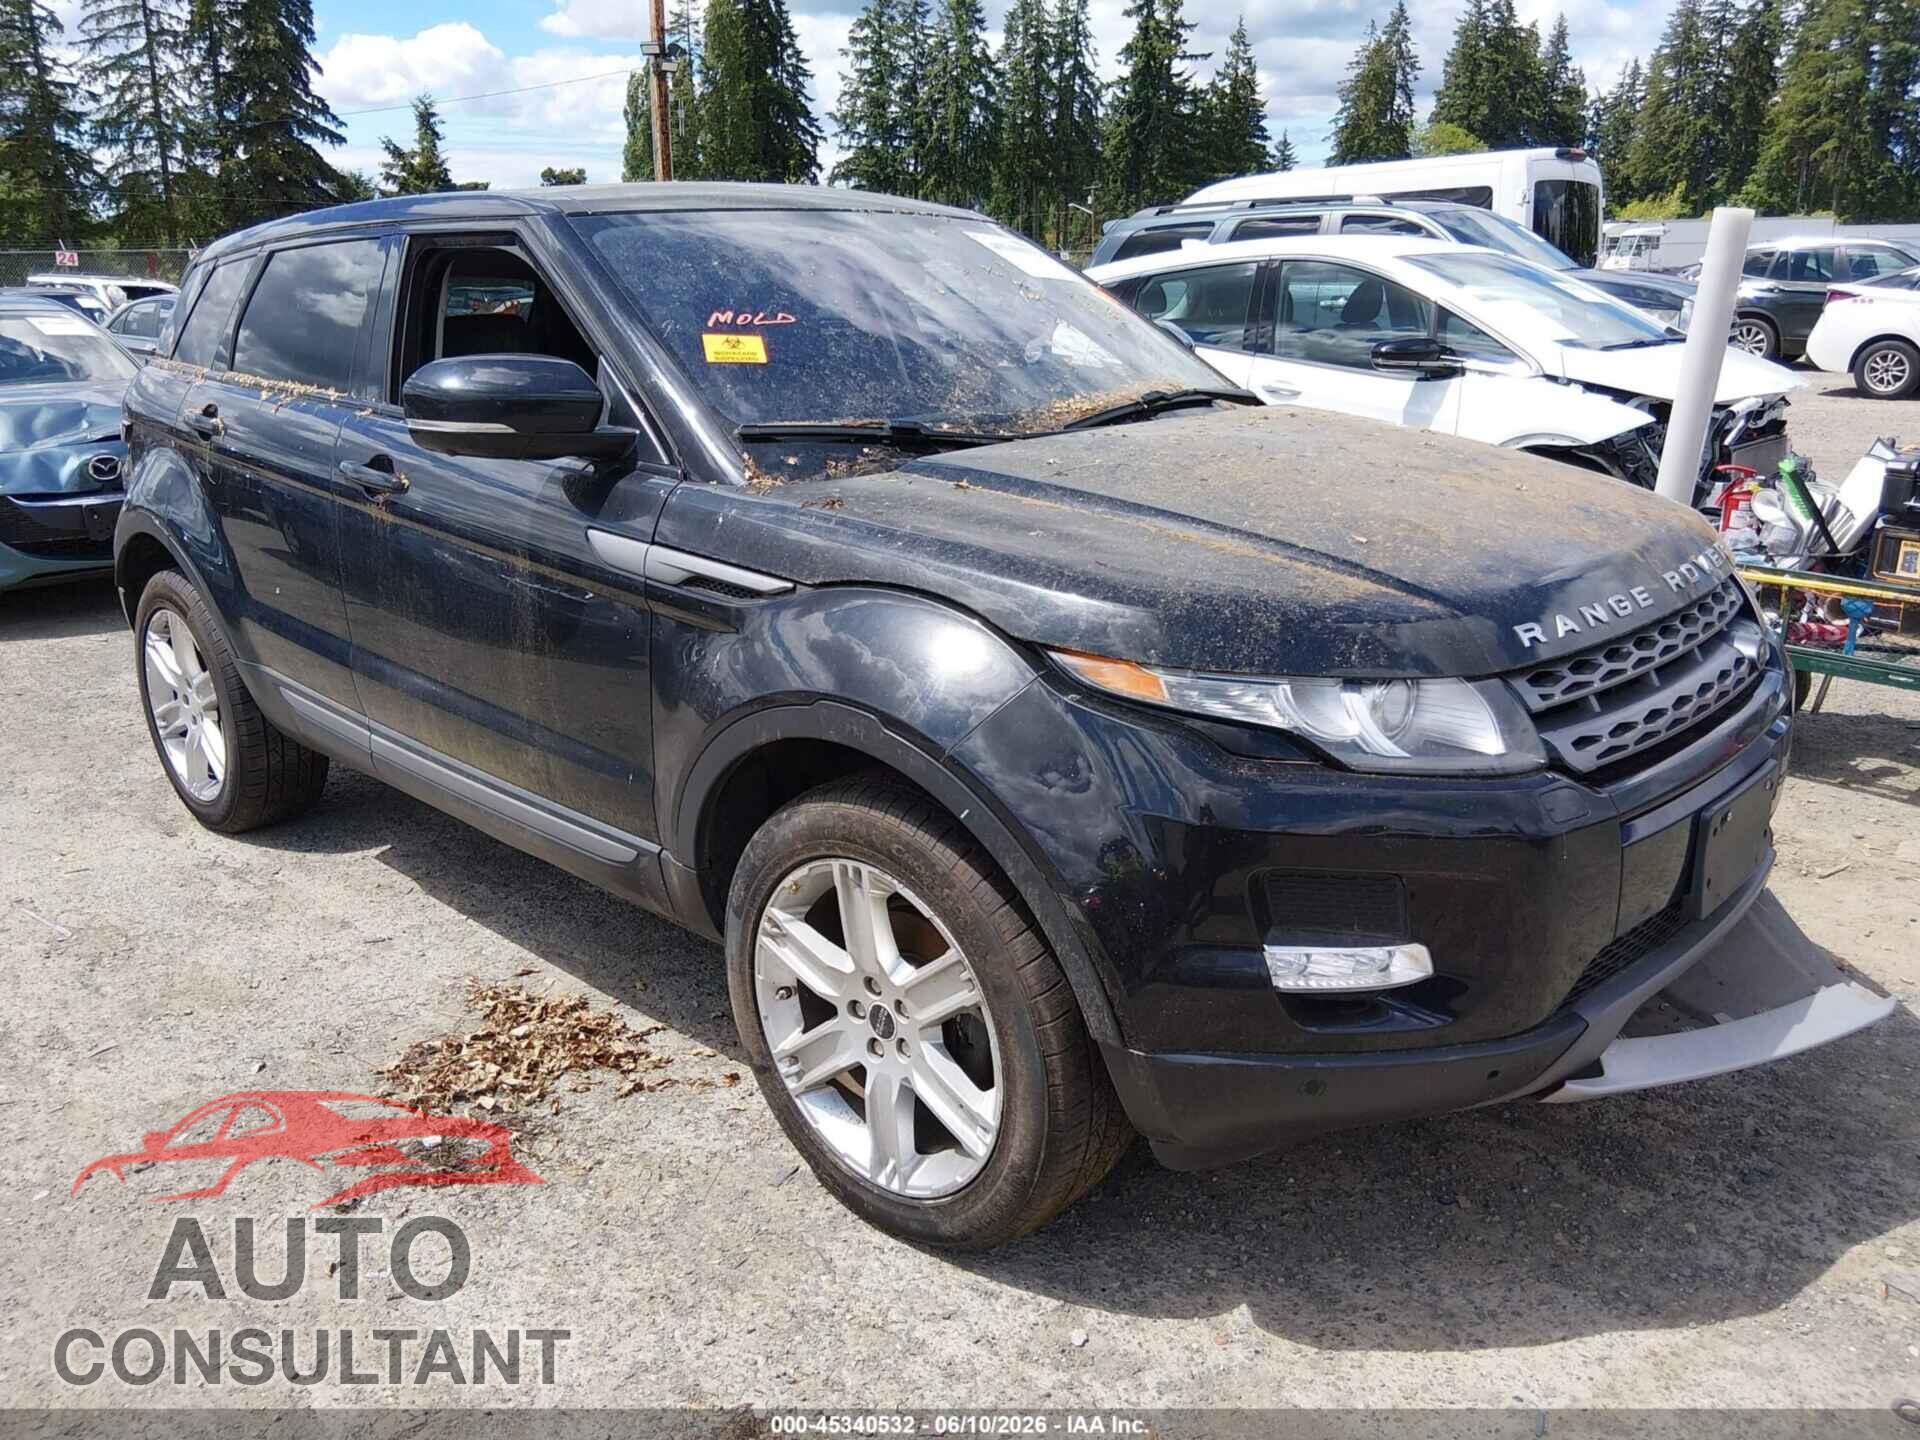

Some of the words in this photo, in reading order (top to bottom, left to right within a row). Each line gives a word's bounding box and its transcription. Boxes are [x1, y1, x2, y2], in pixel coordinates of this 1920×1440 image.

[57, 253, 76, 265] 24
[707, 310, 797, 327] MOLD
[1513, 586, 1654, 647] RANGE
[1661, 543, 1728, 593] ROVE
